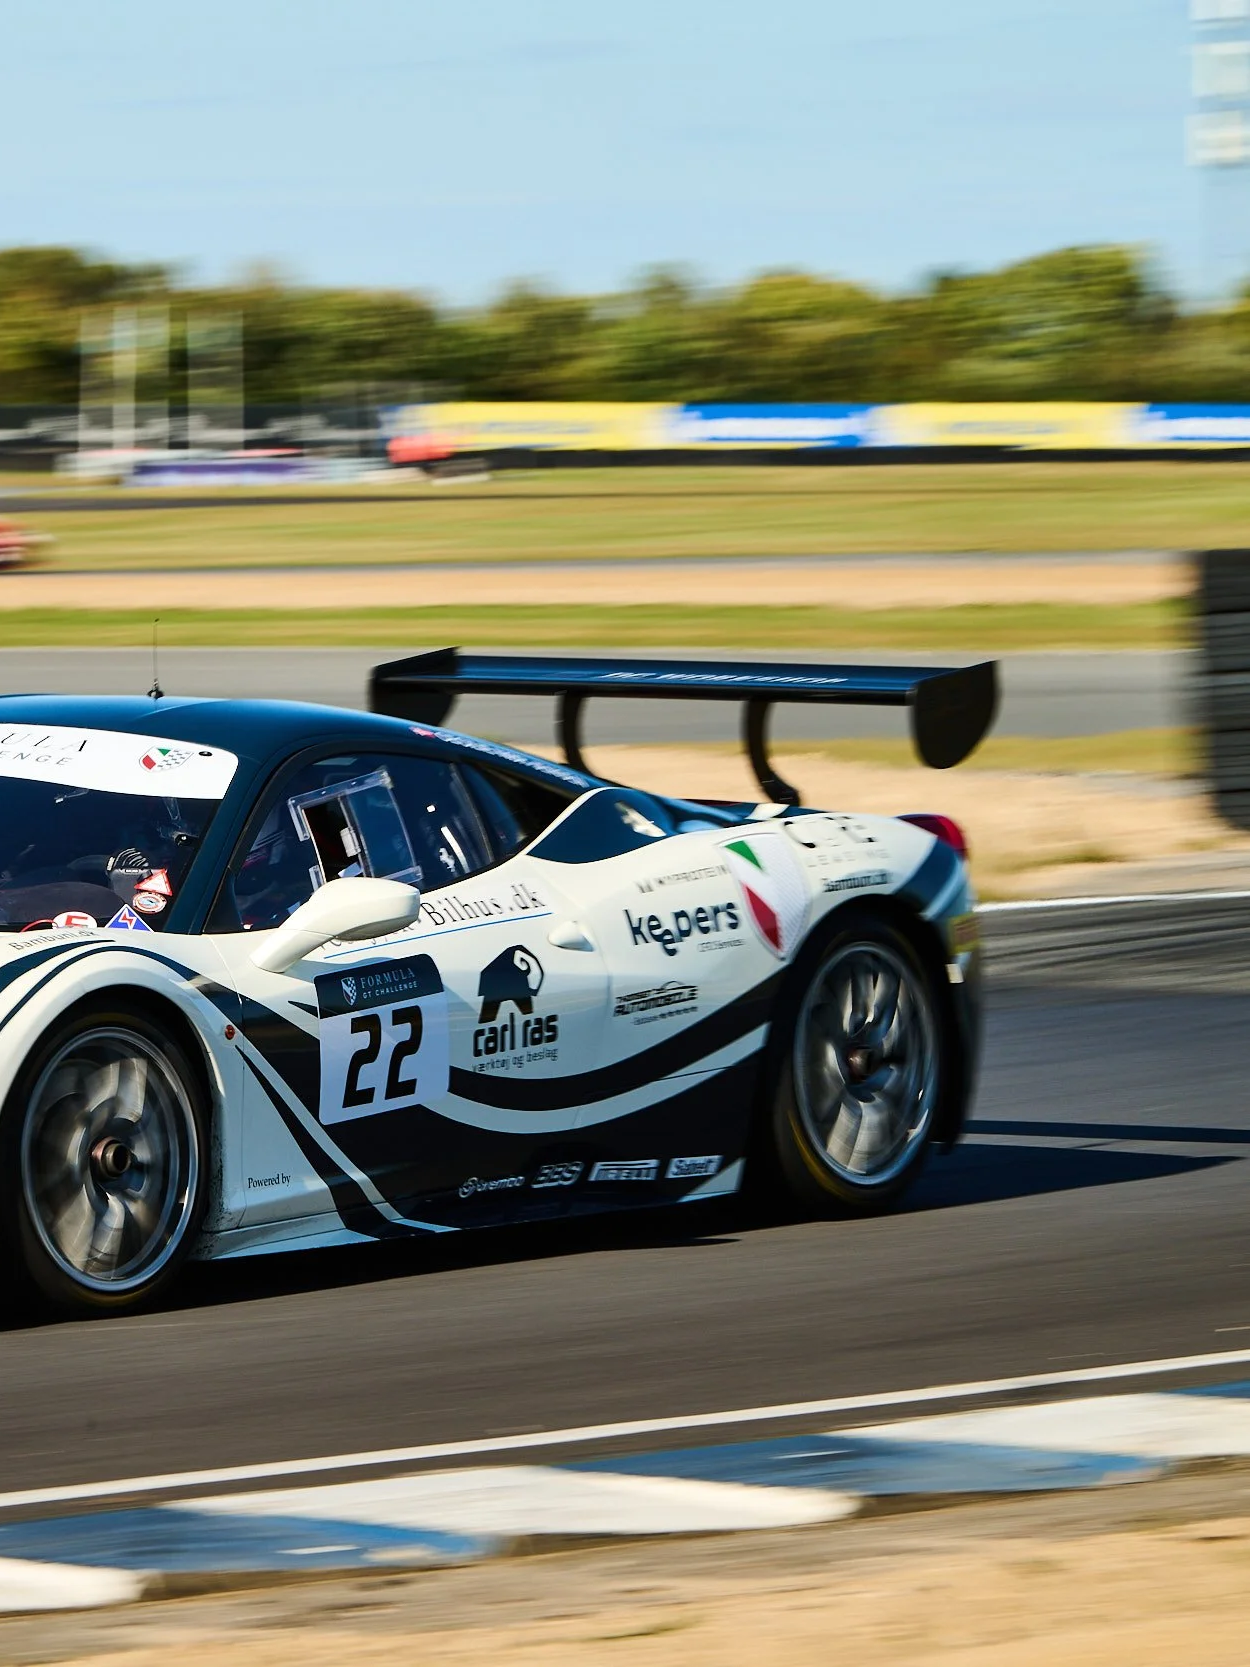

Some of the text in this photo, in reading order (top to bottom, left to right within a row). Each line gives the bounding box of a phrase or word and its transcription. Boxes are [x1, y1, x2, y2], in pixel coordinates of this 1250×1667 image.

[420, 883, 545, 926] Bilhus.dk
[623, 901, 739, 957] keepers
[360, 967, 416, 989] FORMULA
[363, 980, 418, 999] GT CHALLENGE
[473, 1012, 558, 1057] carl ras
[342, 1004, 423, 1109] 22
[512, 1055, 525, 1069] og
[526, 1047, 559, 1062] beslag
[247, 1172, 291, 1189] Powered by
